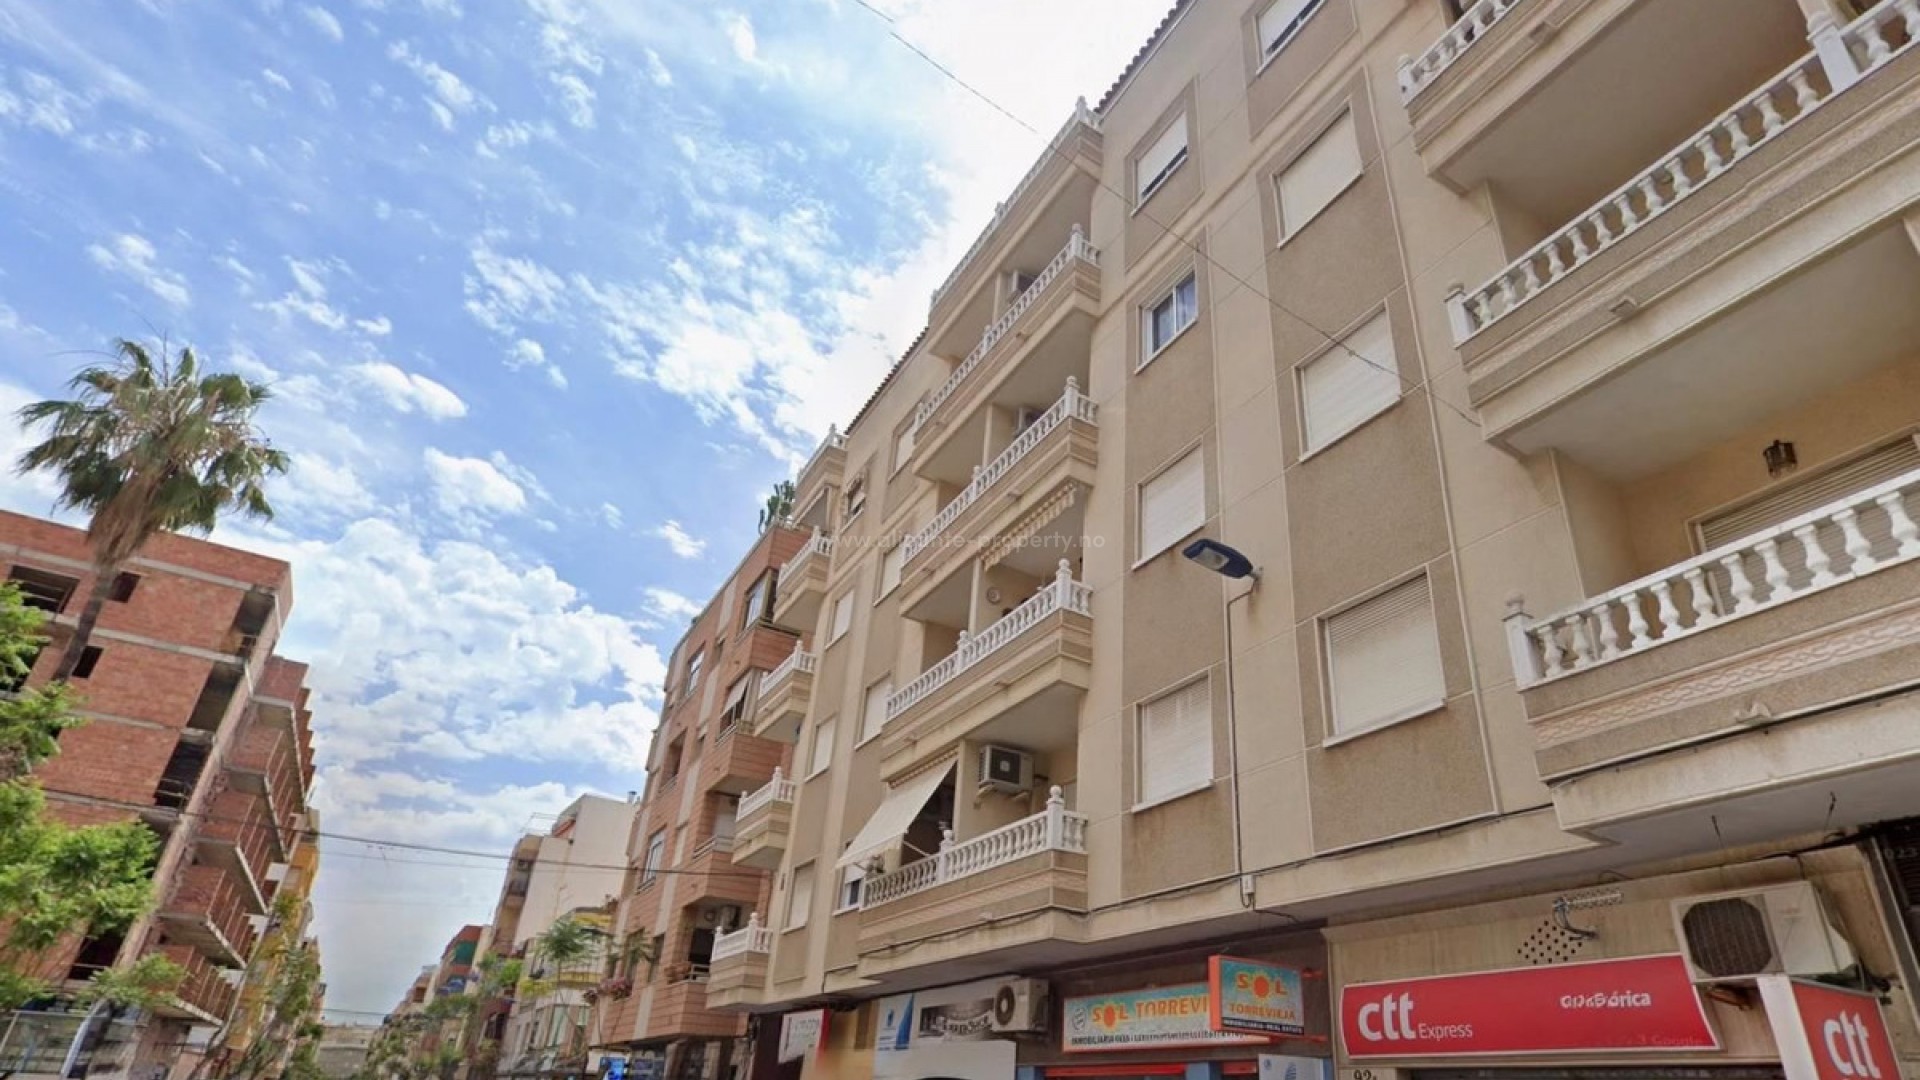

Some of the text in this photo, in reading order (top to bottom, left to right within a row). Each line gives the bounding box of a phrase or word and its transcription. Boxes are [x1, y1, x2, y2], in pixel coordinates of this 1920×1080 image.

[1236, 973, 1288, 998] SOL
[1092, 1003, 1129, 1028] SOL
[1358, 993, 1473, 1041] ctt Express
[1823, 1010, 1882, 1079] ctt
